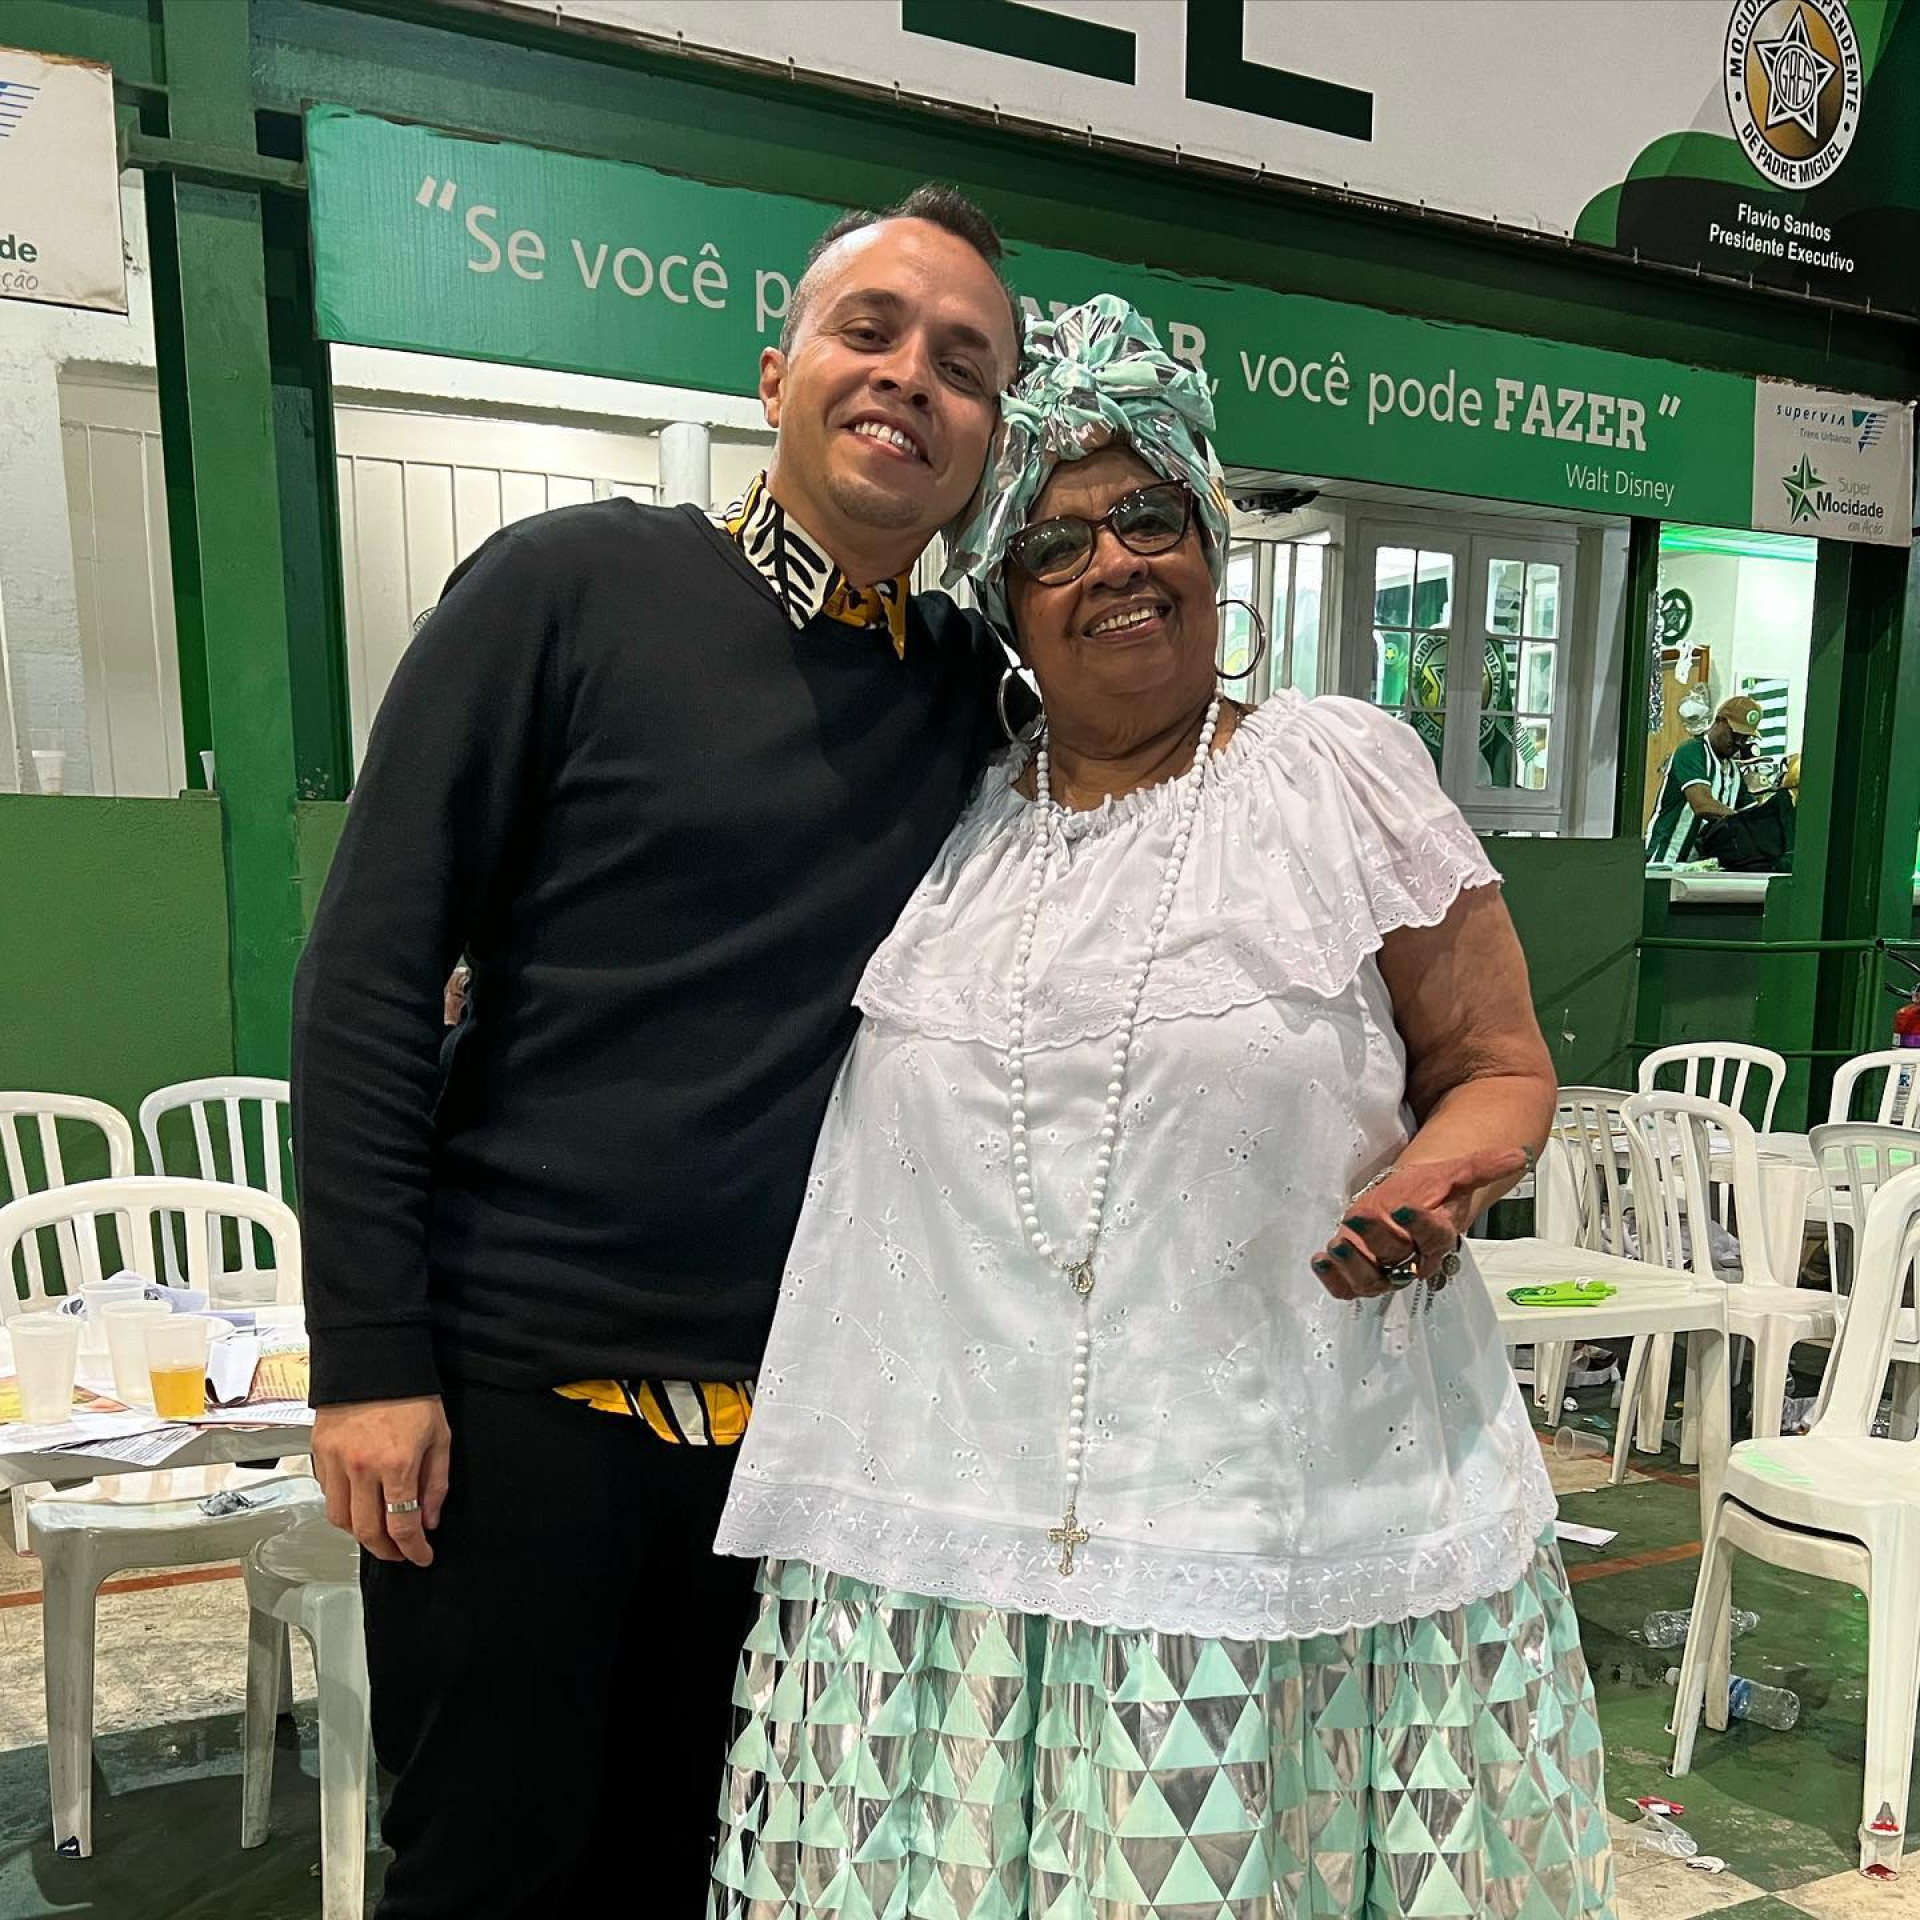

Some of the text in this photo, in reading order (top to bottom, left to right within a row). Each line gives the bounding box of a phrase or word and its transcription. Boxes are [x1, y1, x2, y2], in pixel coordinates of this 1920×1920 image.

[1730, 0, 1859, 113] MOCID PENDENTE
[1742, 121, 1844, 184] DE PADRE MIGUEL
[1737, 203, 1832, 242] Flavio Santos
[1709, 223, 1855, 273] Presidente Executivo
[0, 269, 39, 293] ção
[571, 239, 729, 309] você
[1239, 351, 1350, 406] você
[1368, 369, 1482, 427] pode
[1566, 463, 1675, 508] Walt Disney
[1816, 491, 1884, 519] Mocidade
[1838, 477, 1871, 498] Super
